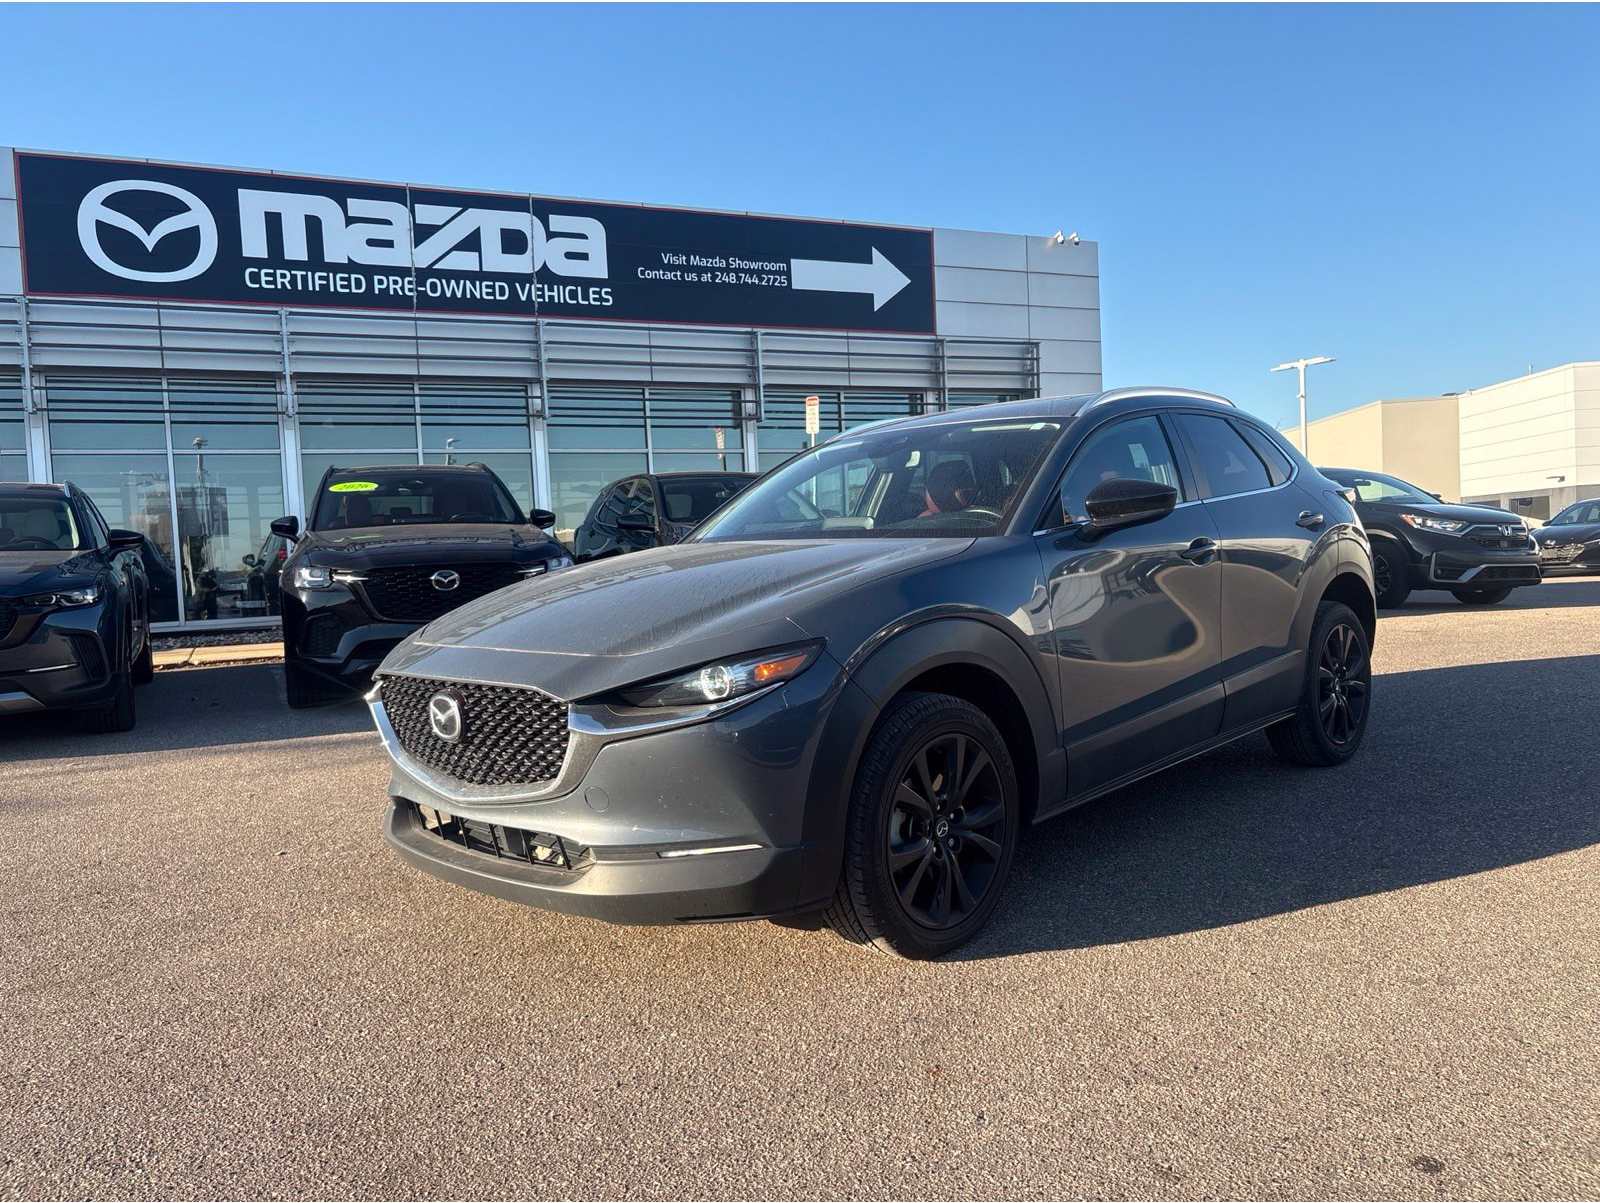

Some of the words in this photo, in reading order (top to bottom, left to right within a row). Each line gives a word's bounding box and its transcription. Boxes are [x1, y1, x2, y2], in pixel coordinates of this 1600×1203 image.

[661, 252, 688, 265] Visit
[689, 255, 727, 268] Mazda
[728, 257, 787, 271] Showroom
[244, 267, 367, 294] CERTIFIED
[373, 274, 510, 301] PRE-OWNED
[515, 282, 613, 306] VEHICLES
[637, 267, 682, 281] Contact
[684, 272, 698, 282] us
[700, 271, 712, 282] at
[714, 271, 788, 287] 248.744.2725
